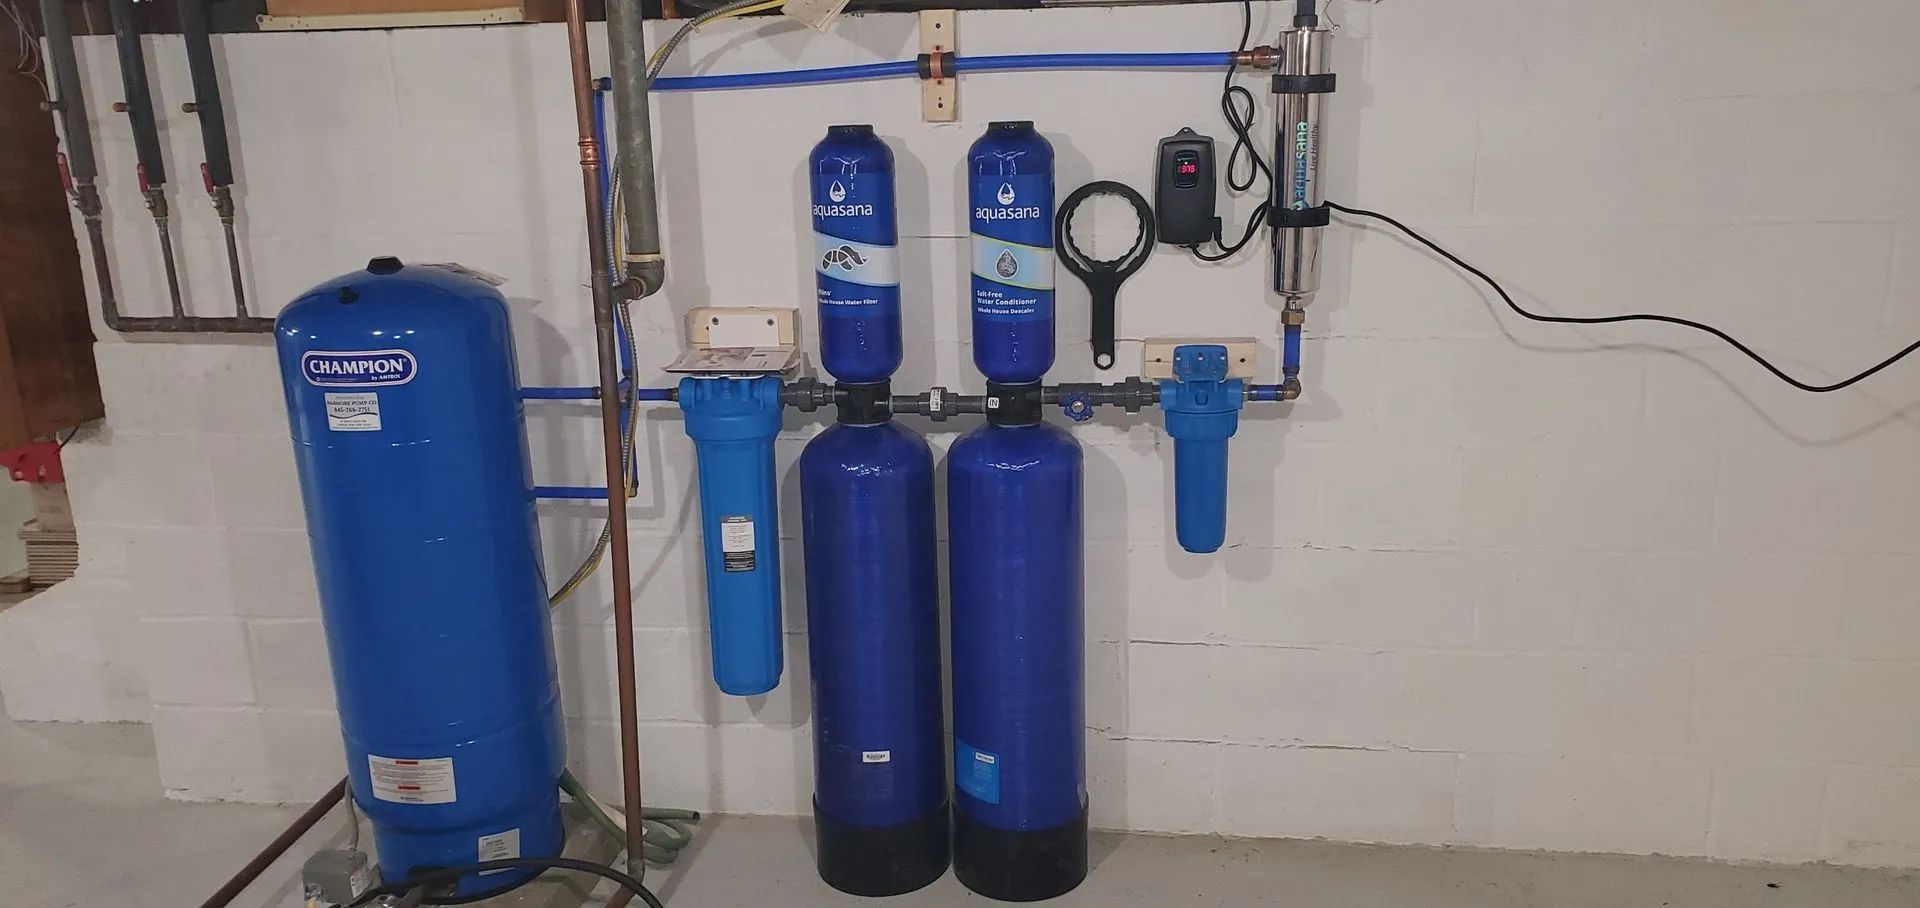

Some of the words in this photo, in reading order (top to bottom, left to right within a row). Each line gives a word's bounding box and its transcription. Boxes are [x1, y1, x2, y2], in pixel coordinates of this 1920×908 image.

[1295, 121, 1310, 198] aquasana
[813, 204, 873, 221] aquasana
[975, 206, 1040, 224] aquasana
[977, 290, 1003, 298] Salt-Free
[995, 298, 1037, 306] Conditioner
[977, 306, 991, 314] Whole
[309, 358, 404, 375] CHAMPION
